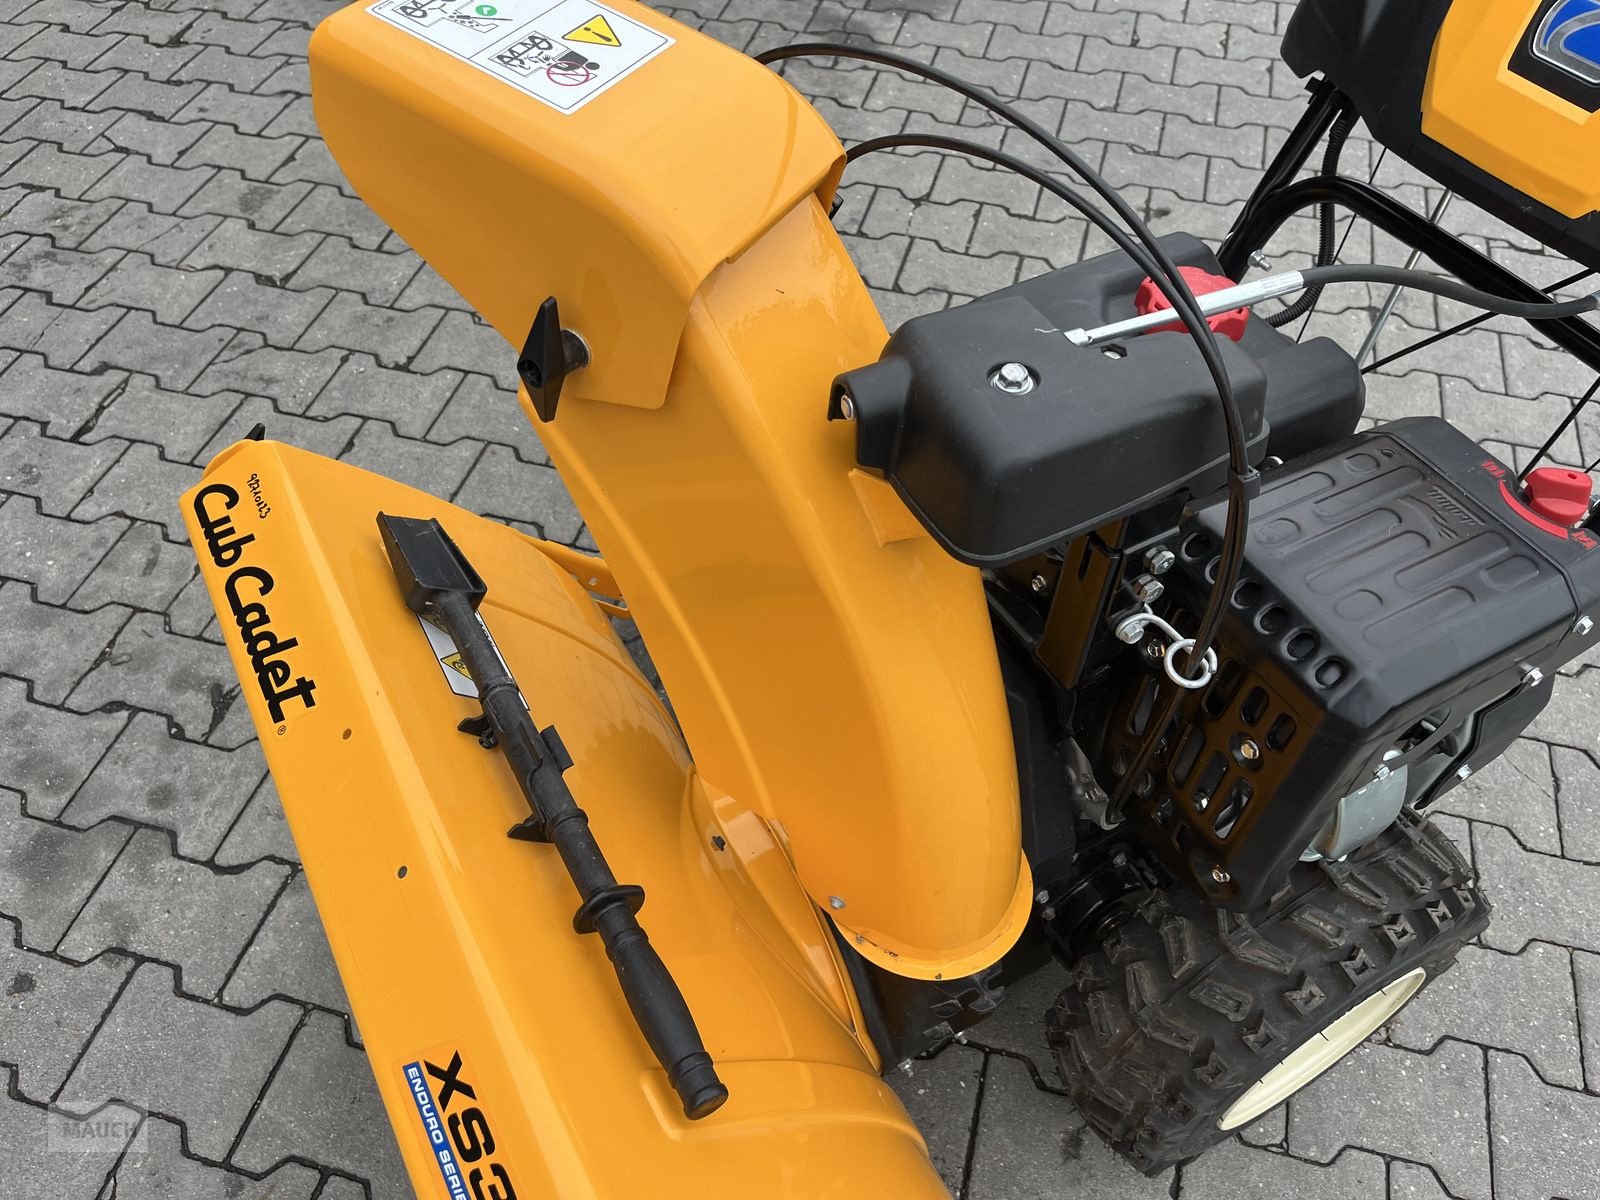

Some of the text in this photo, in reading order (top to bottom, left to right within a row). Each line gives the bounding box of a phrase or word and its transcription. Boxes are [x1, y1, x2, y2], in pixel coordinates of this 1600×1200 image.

[193, 483, 317, 724] Cub Cadet
[407, 1066, 444, 1144] ENDURO
[423, 1049, 518, 1200] XS3
